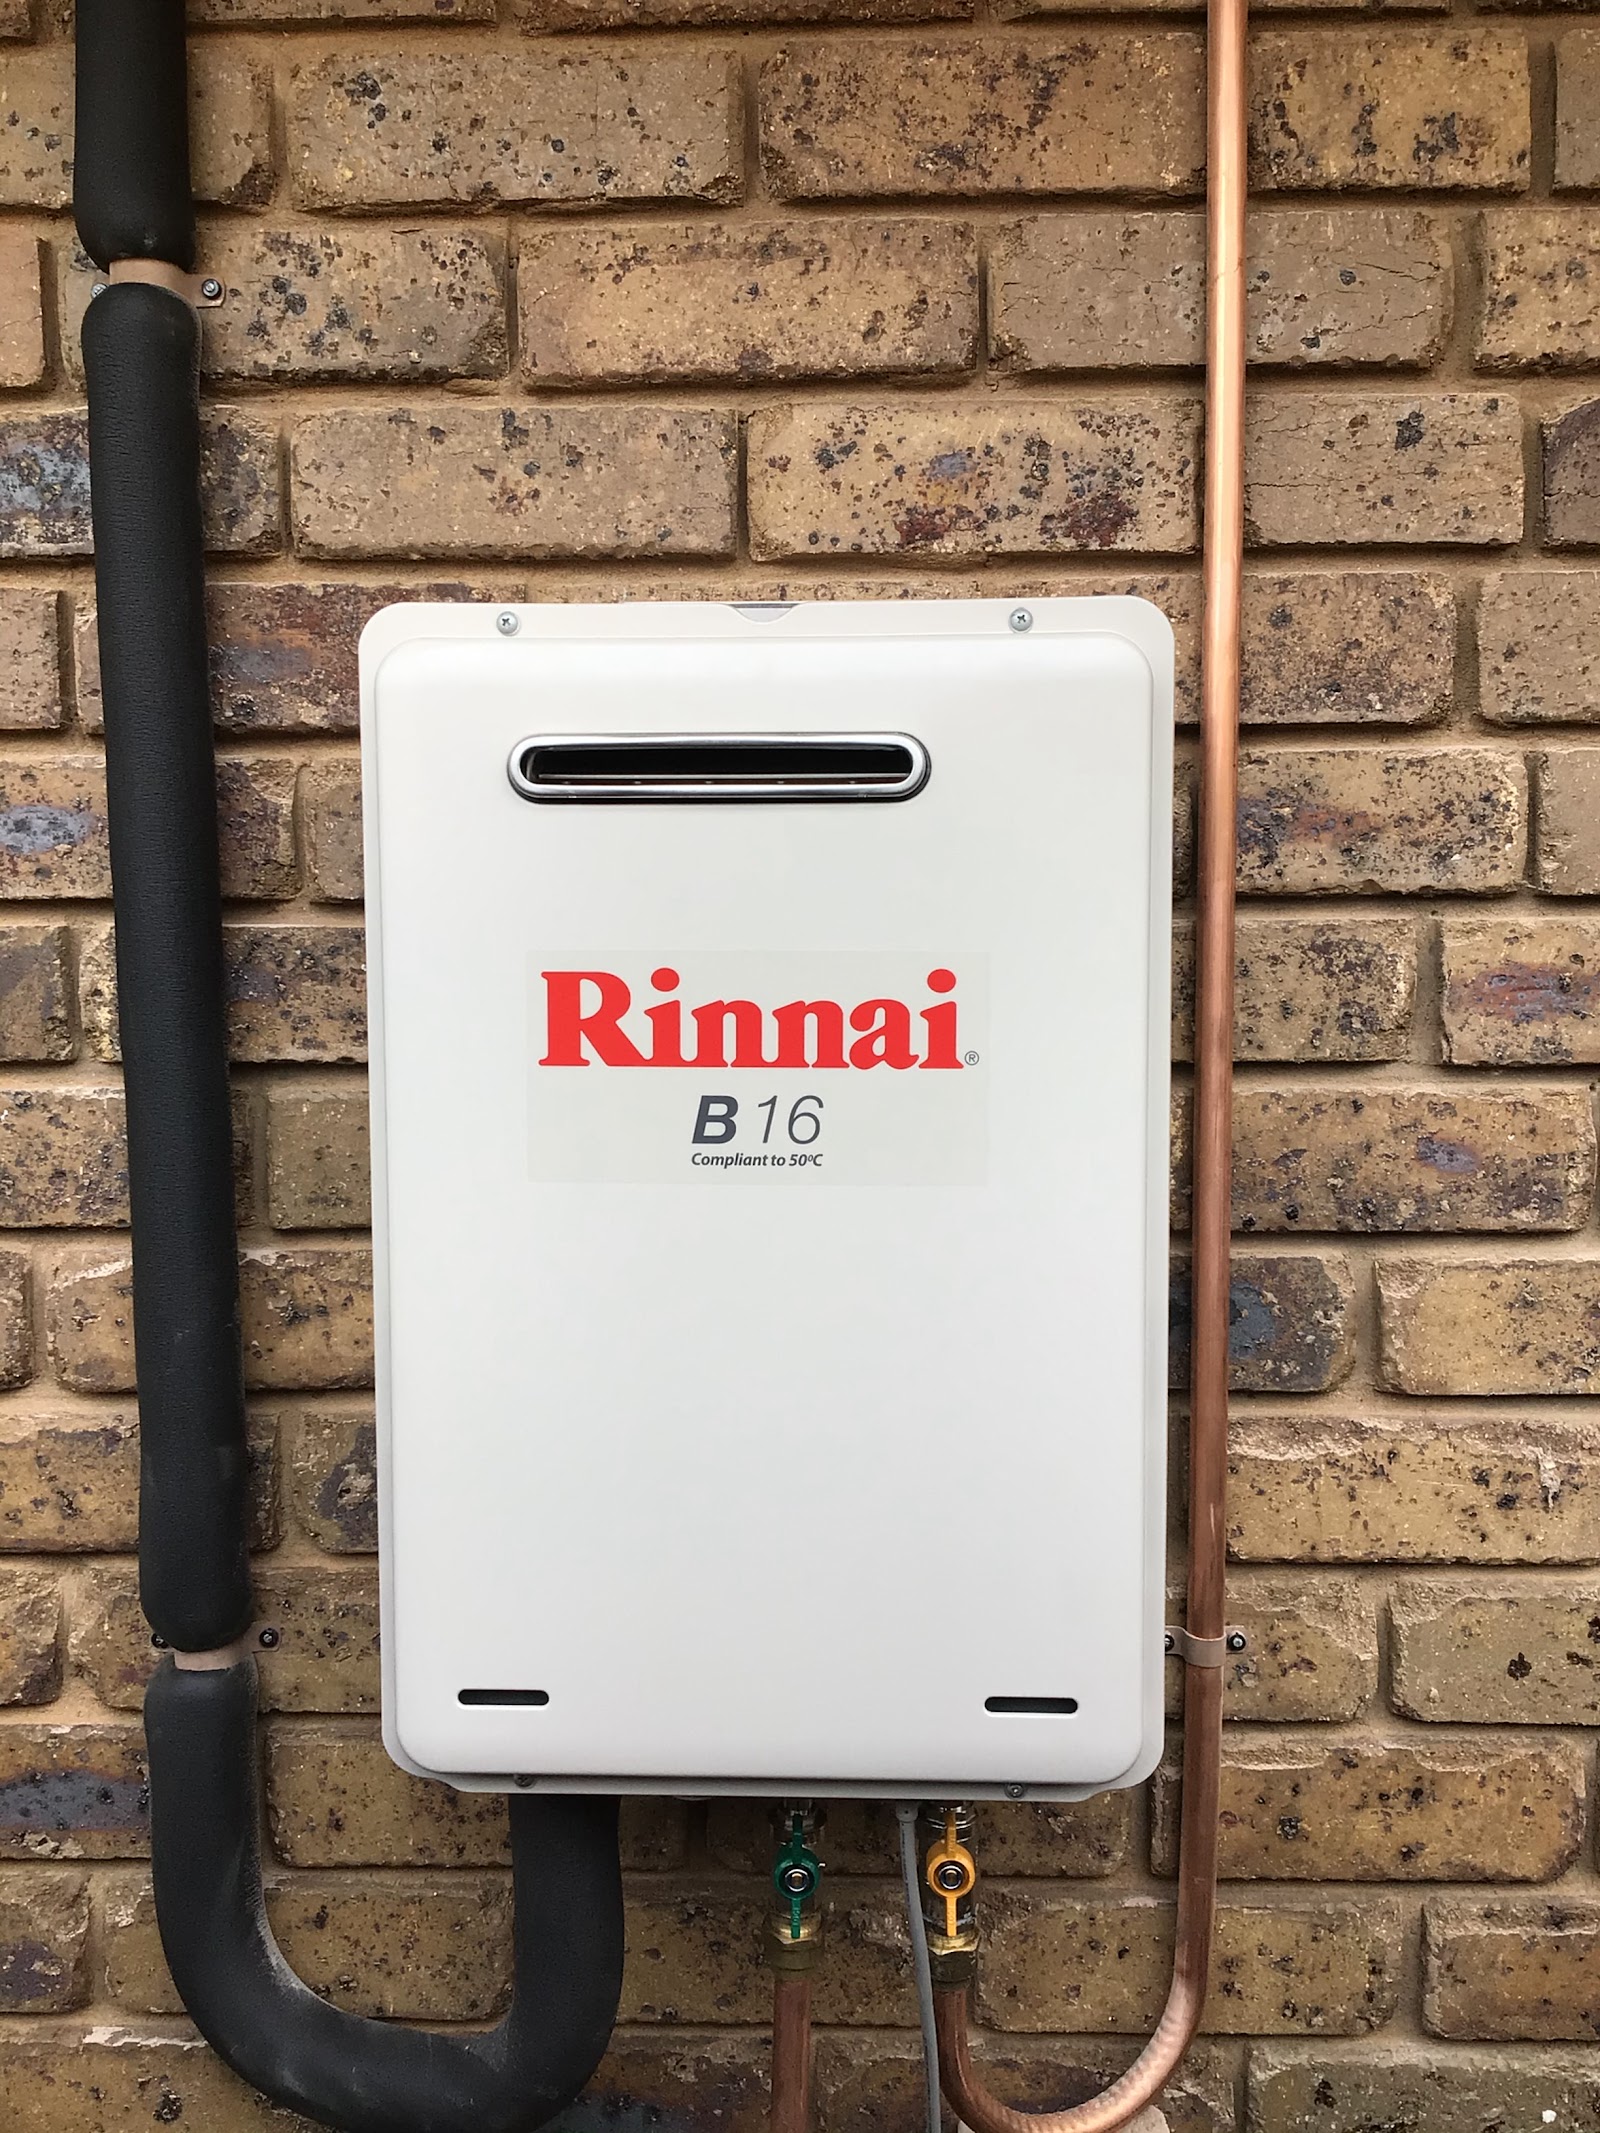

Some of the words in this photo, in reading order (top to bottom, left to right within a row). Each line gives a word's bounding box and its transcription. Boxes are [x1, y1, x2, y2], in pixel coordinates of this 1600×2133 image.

[691, 1095, 739, 1144] B
[757, 1095, 824, 1145] 16
[691, 1152, 768, 1169] Compliant
[770, 1154, 786, 1167] to
